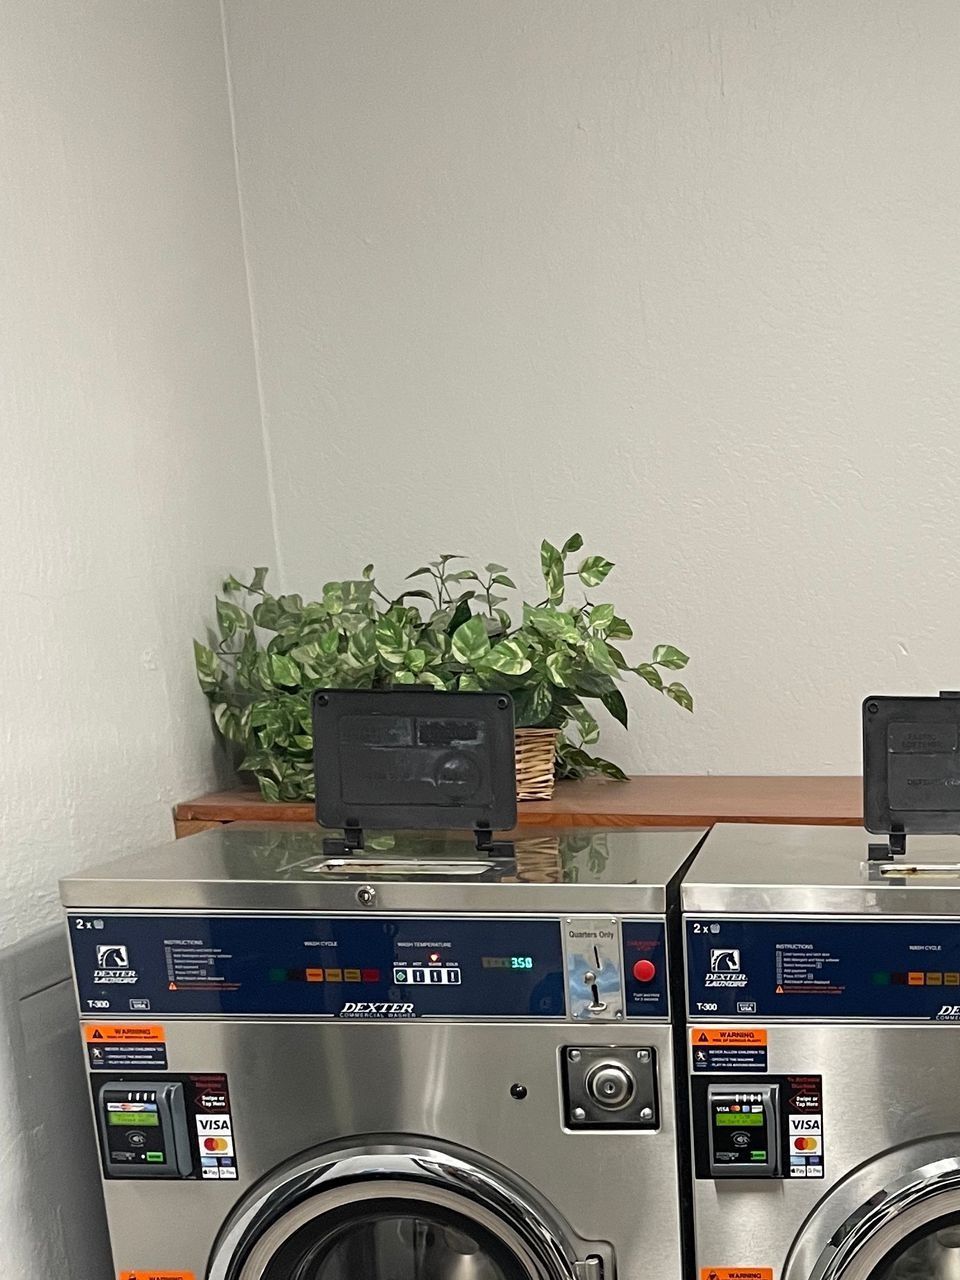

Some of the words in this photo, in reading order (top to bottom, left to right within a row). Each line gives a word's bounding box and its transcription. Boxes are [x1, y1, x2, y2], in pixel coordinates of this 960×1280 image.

[76, 919, 84, 929] 2
[86, 921, 92, 929] x
[693, 923, 701, 934] 2
[702, 926, 709, 934] x
[568, 931, 597, 939] Quarters
[600, 931, 614, 940] Only
[87, 1000, 110, 1008] T-300
[341, 1002, 415, 1013] DEXTER
[696, 1002, 718, 1011] T-300
[719, 1031, 755, 1039] WARNING
[199, 1119, 230, 1130] VISA
[790, 1119, 820, 1130] VISA
